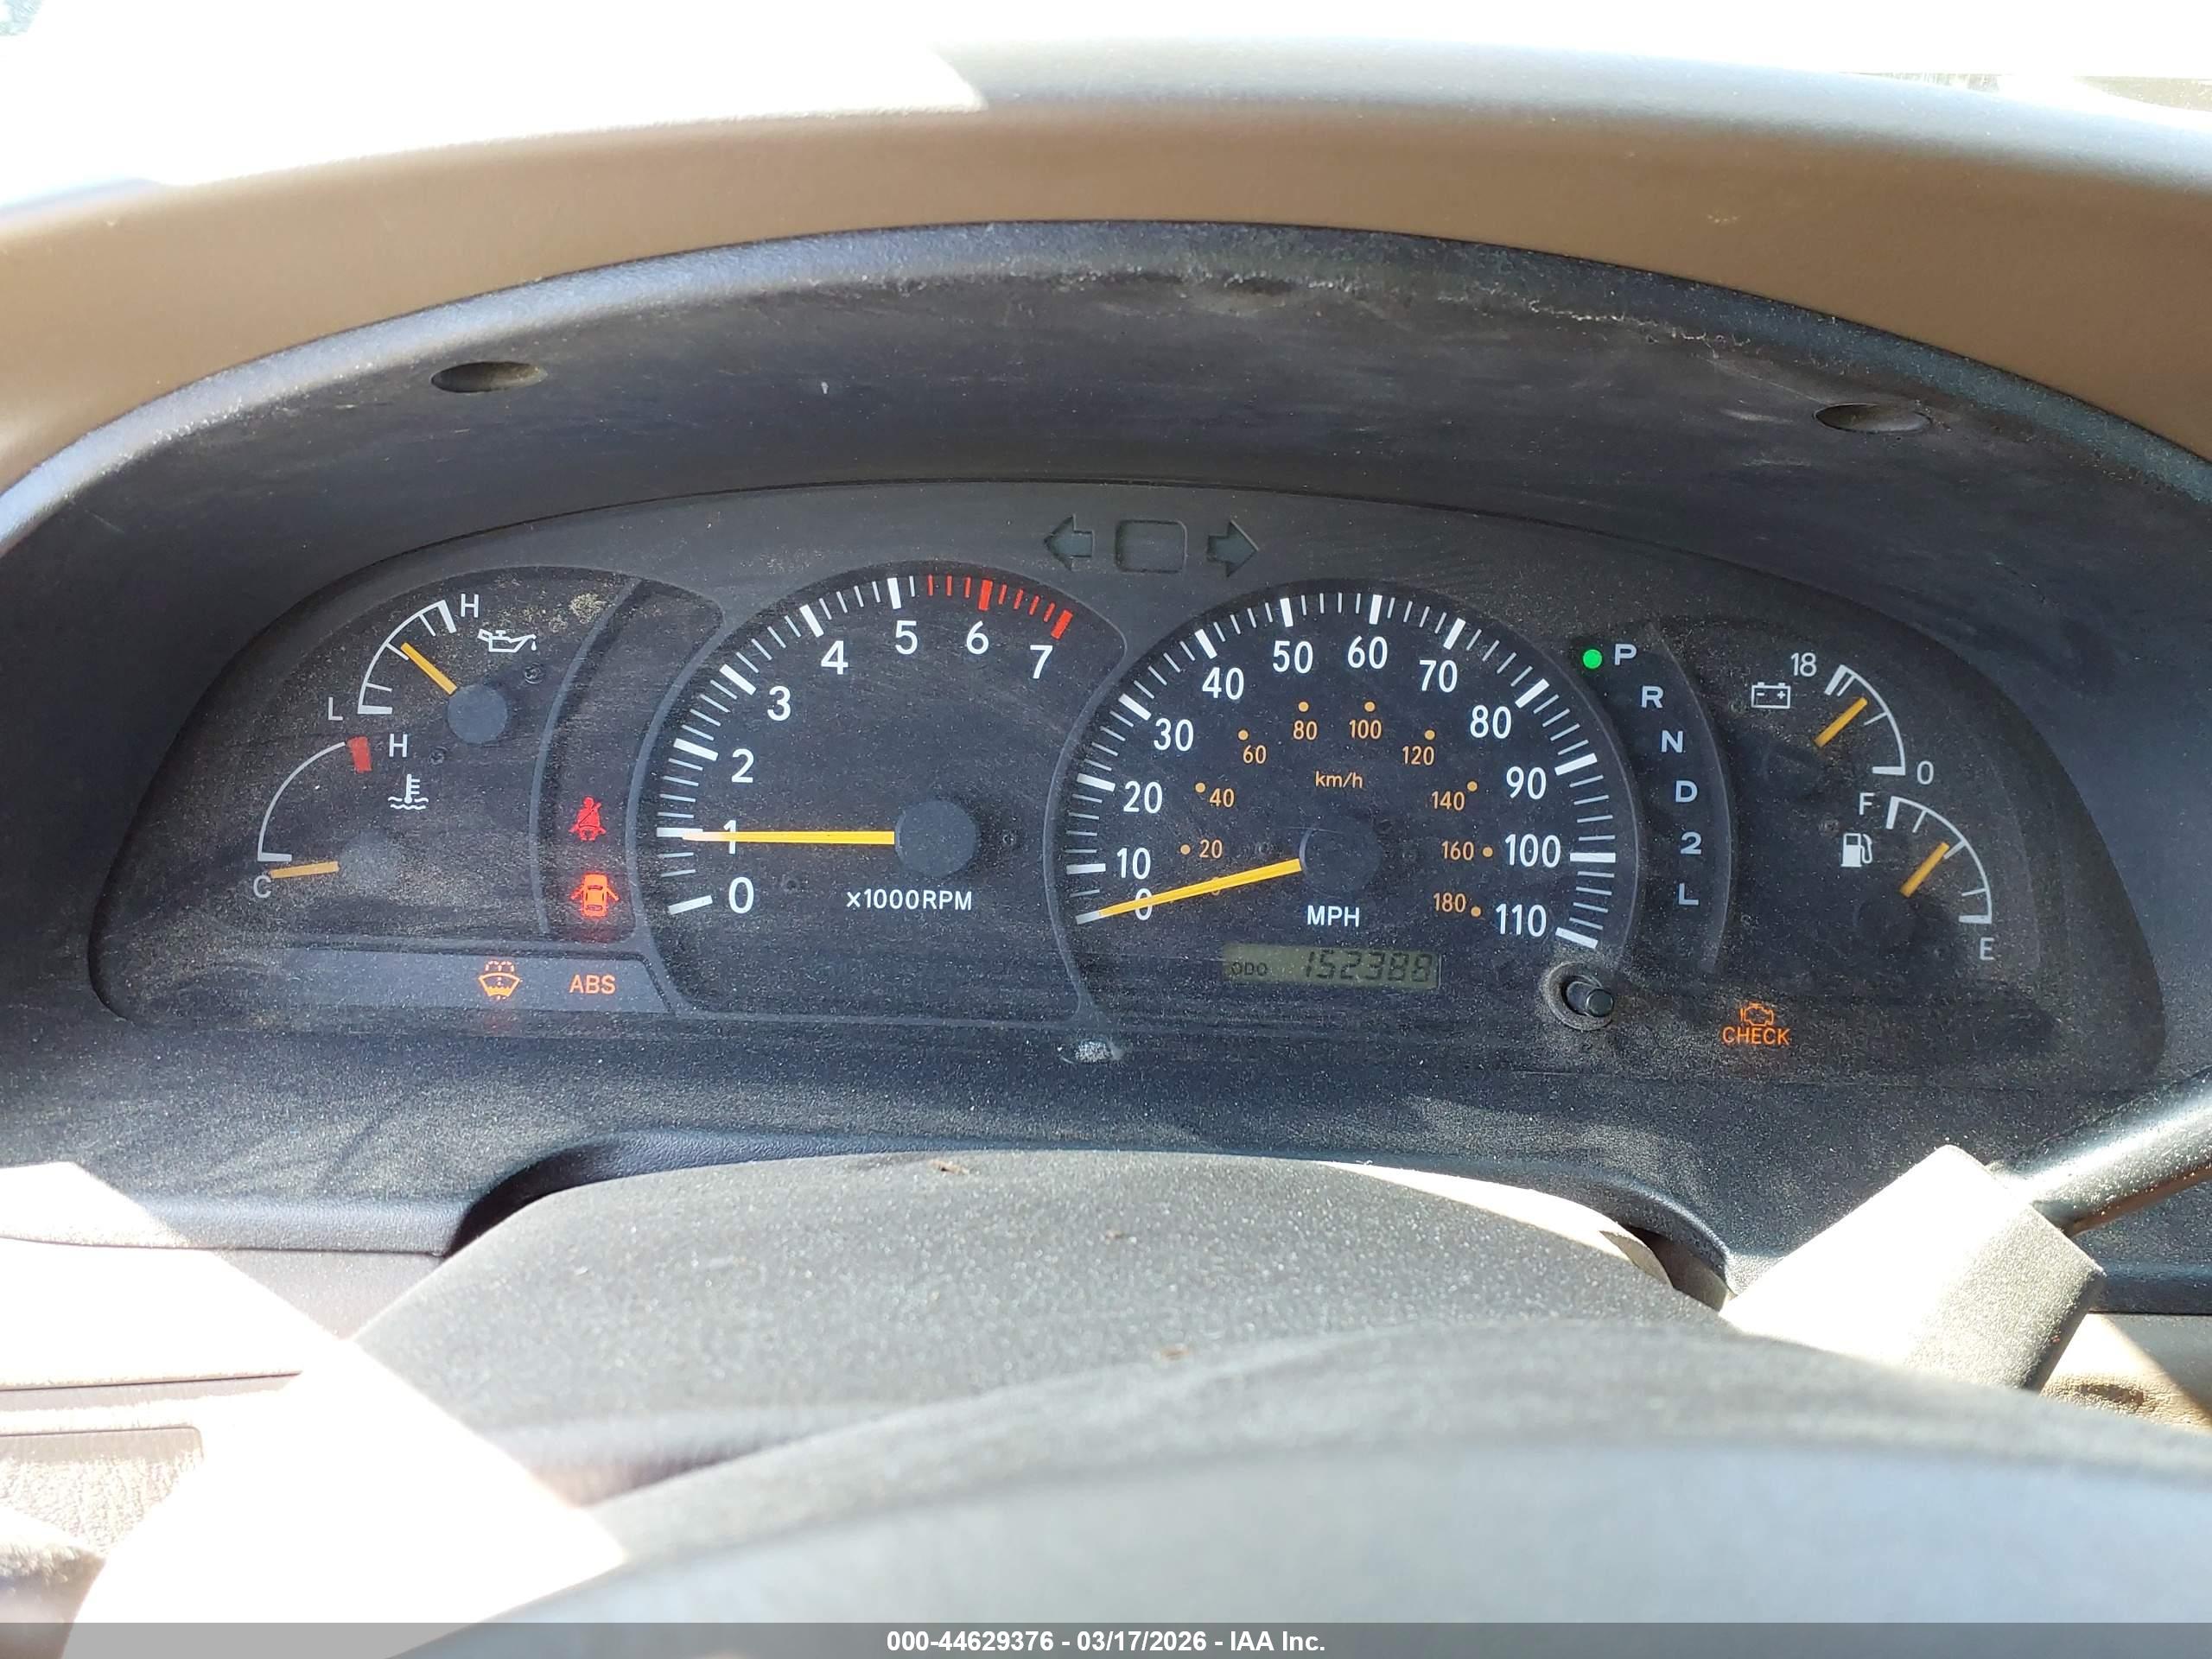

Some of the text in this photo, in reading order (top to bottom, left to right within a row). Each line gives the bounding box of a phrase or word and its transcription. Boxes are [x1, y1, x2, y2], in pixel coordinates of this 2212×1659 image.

[461, 594, 479, 617] H
[895, 620, 918, 654] 5
[965, 621, 988, 654] 6
[821, 641, 848, 674] 4
[1030, 645, 1052, 678] 7
[1274, 641, 1313, 673] 50
[1348, 636, 1387, 669] 60
[1615, 644, 1637, 664] P
[1420, 660, 1457, 692] 70
[1791, 653, 1816, 677] 18
[1203, 667, 1243, 700] 40
[328, 697, 343, 721] L
[767, 686, 791, 721] 3
[1642, 686, 1662, 708] R
[1294, 721, 1317, 740] 80
[1350, 720, 1381, 739] 100
[1471, 705, 1511, 739] 80
[390, 734, 410, 757] H
[1154, 718, 1193, 751] 30
[1662, 731, 1682, 753] N
[732, 749, 753, 783] 2
[1243, 746, 1266, 763] 60
[1403, 747, 1433, 765] 120
[1316, 772, 1365, 788] km/h
[1507, 766, 1546, 799] 90
[1917, 761, 1933, 785] 0
[1124, 781, 1162, 813] 20
[1210, 789, 1234, 807] 40
[1432, 791, 1464, 810] 140
[1675, 781, 1697, 802] D
[1859, 792, 1874, 815] F
[722, 819, 737, 855] 1
[1199, 840, 1222, 858] 20
[1681, 832, 1701, 854] 2
[1442, 842, 1473, 860] 160
[1505, 834, 1560, 868] 100
[1117, 848, 1150, 879] 10
[254, 874, 271, 898] C
[729, 877, 753, 913] 0
[1679, 883, 1699, 905] L
[1134, 887, 1154, 922] 0
[1434, 893, 1465, 912] 180
[1307, 906, 1359, 926] MPH
[1496, 904, 1546, 937] 110
[1980, 938, 1994, 960] E
[1231, 949, 1432, 982] ODO 152388
[570, 975, 615, 994] ABS
[1723, 1025, 1789, 1044] CHECK
